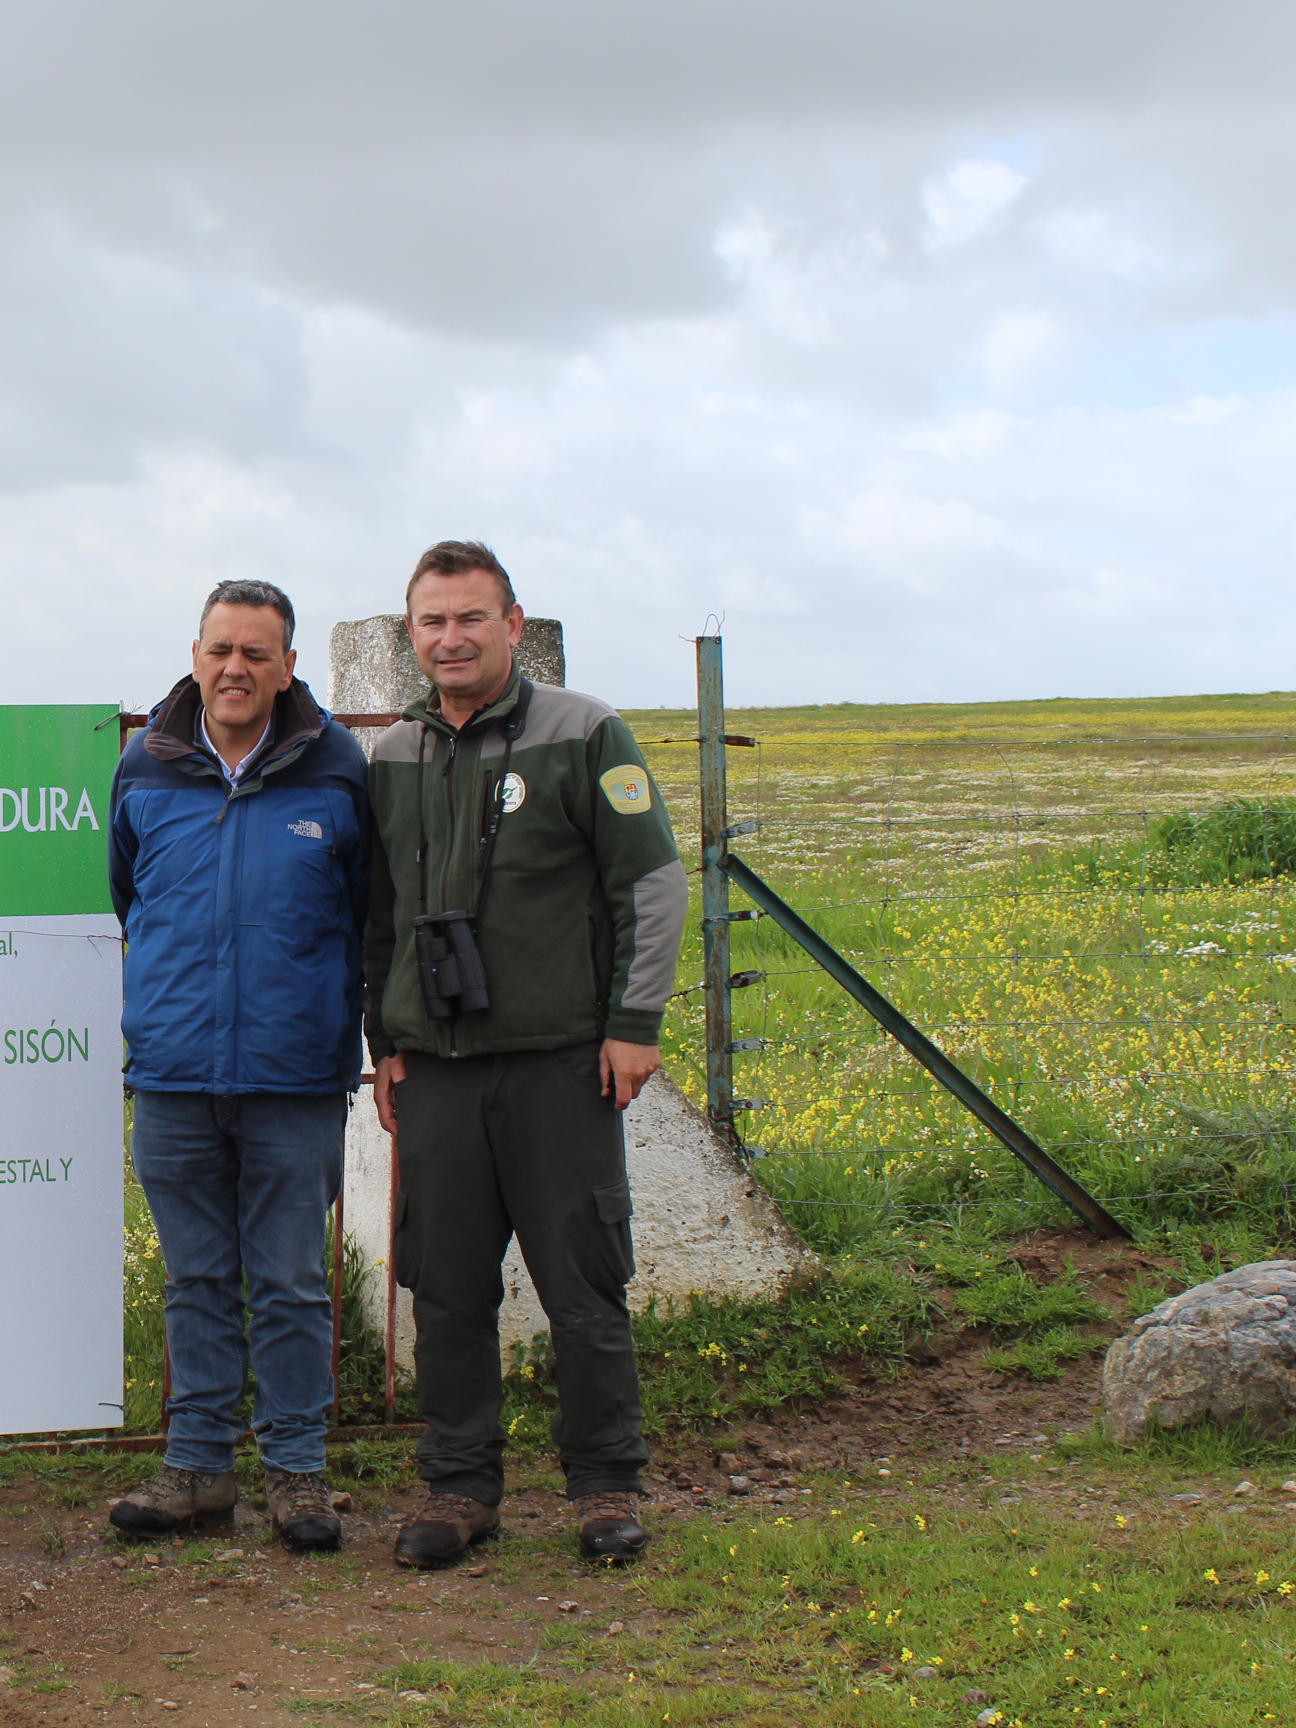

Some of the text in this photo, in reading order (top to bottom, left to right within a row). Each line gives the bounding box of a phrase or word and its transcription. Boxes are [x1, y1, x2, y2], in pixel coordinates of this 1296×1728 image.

[287, 823, 311, 832] NORTH
[298, 820, 312, 828] THE
[294, 829, 312, 837] FACE
[4, 1019, 89, 1064] SISÓN
[59, 1157, 74, 1182] Y
